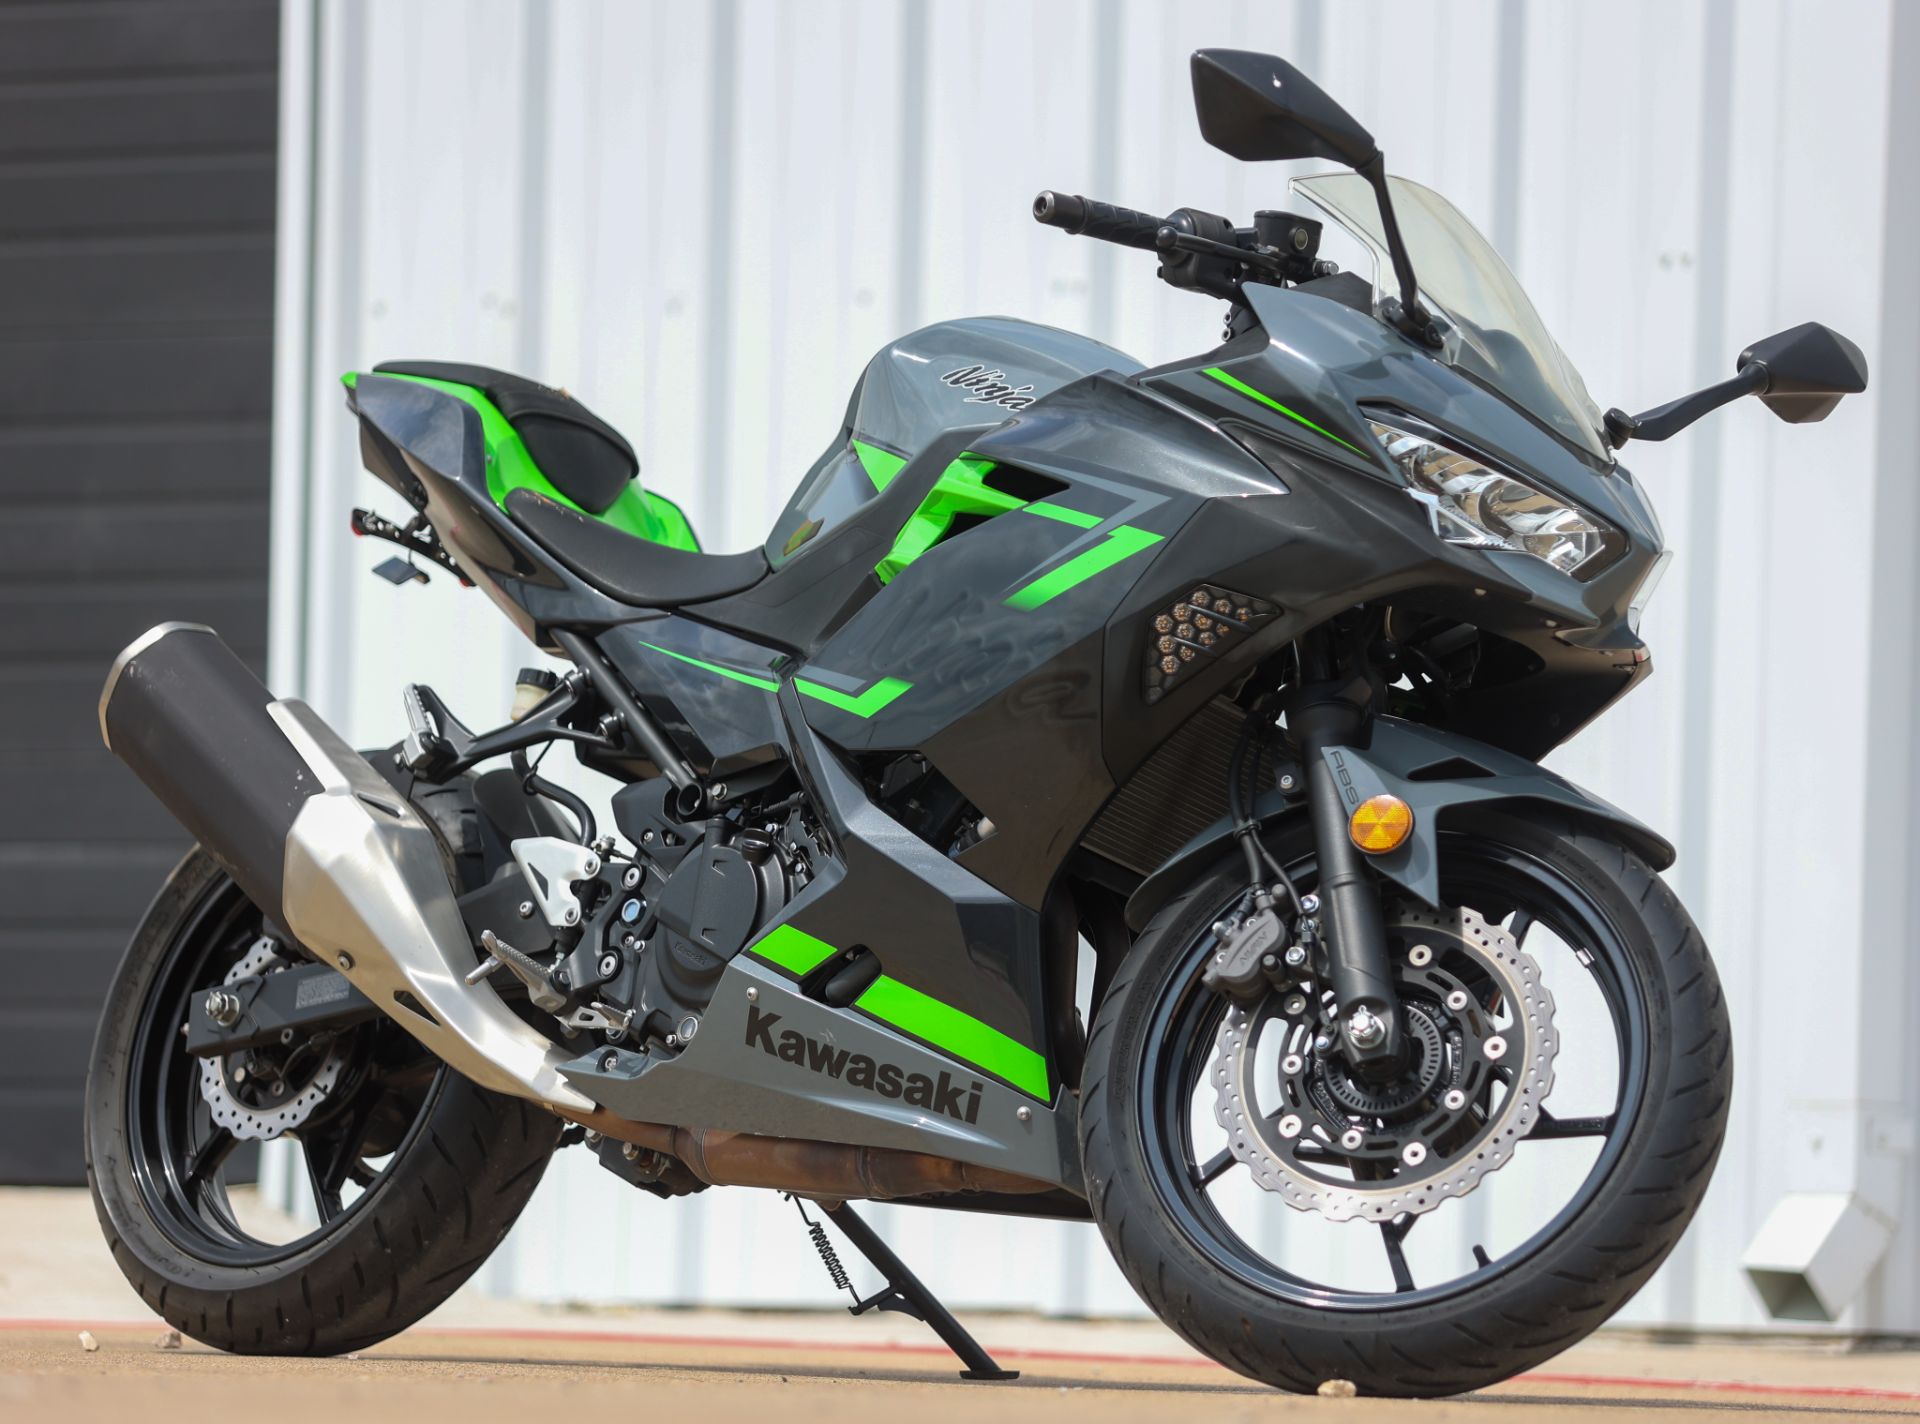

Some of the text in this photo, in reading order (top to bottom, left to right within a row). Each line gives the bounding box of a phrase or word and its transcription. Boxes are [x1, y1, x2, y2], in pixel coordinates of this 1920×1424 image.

[941, 364, 1037, 412] Ninja
[1330, 751, 1360, 805] ABS
[744, 1004, 984, 1125] Kawasaki
